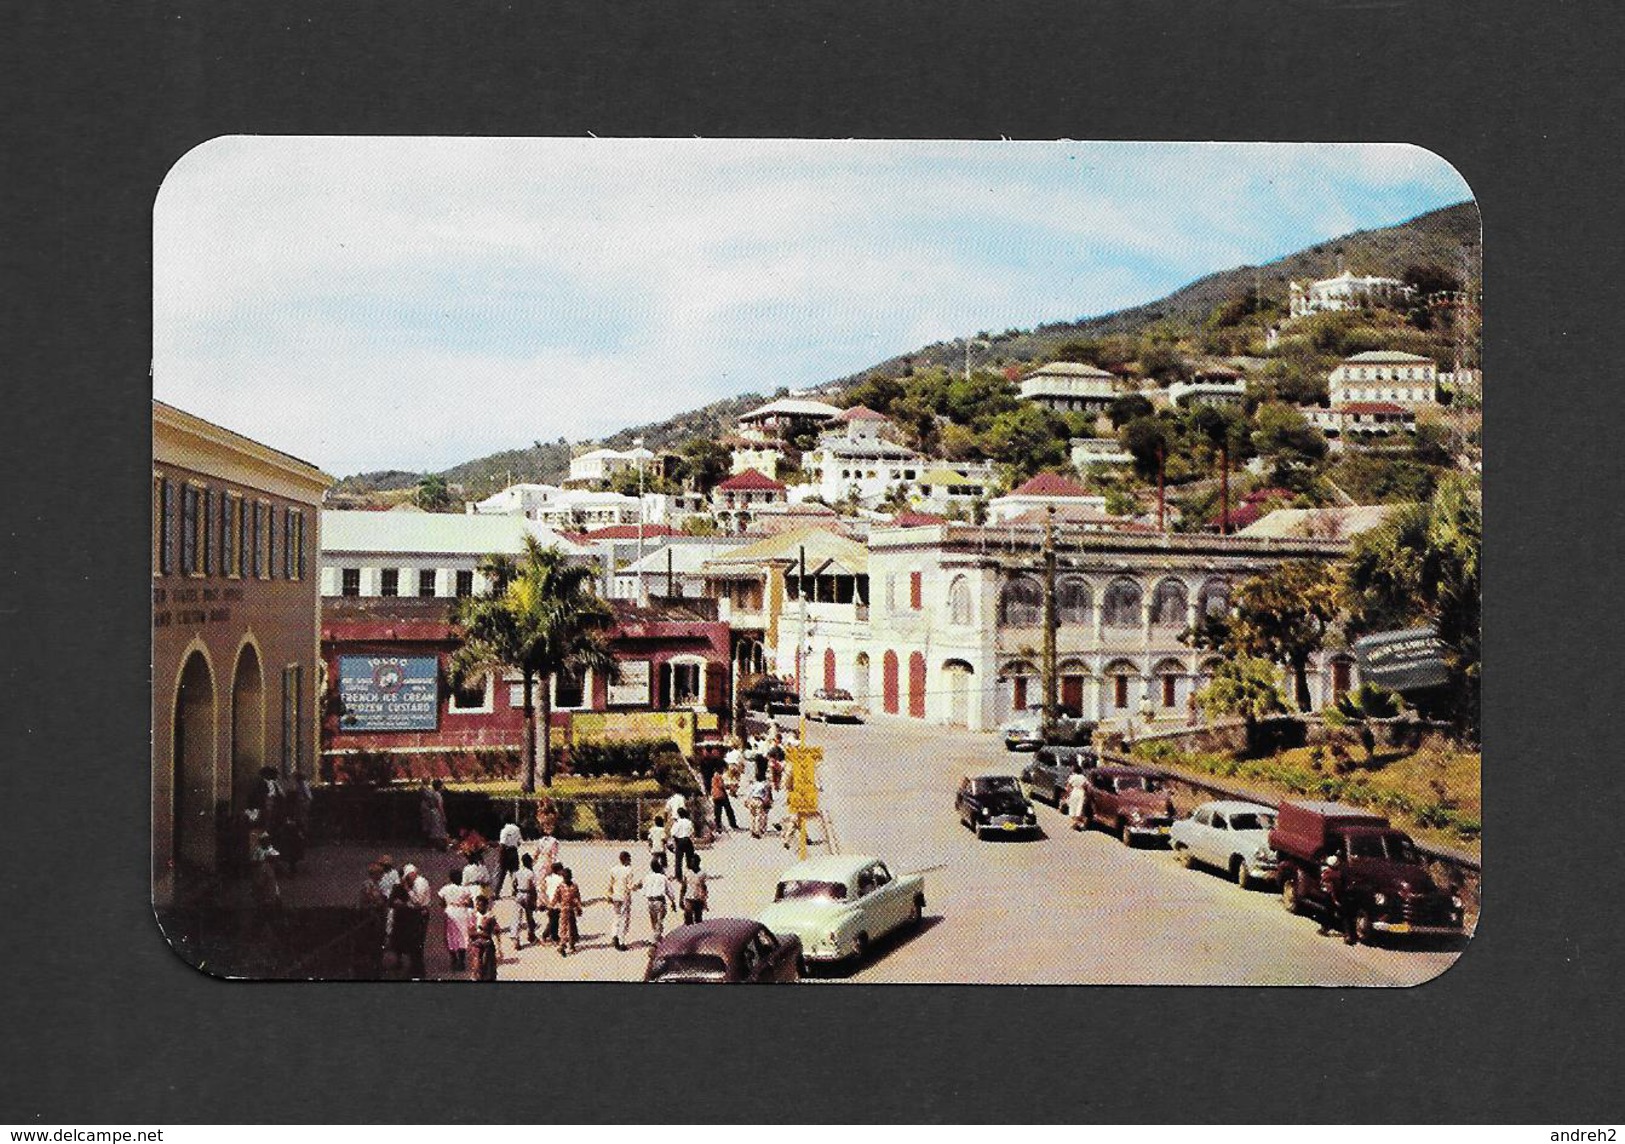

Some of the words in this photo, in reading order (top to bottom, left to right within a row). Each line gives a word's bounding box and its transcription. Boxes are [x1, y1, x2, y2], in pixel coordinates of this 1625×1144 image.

[341, 693, 379, 702] FRENCH
[383, 693, 398, 702] ICE
[403, 693, 435, 702] CREAM
[388, 703, 430, 712] CUSTARD
